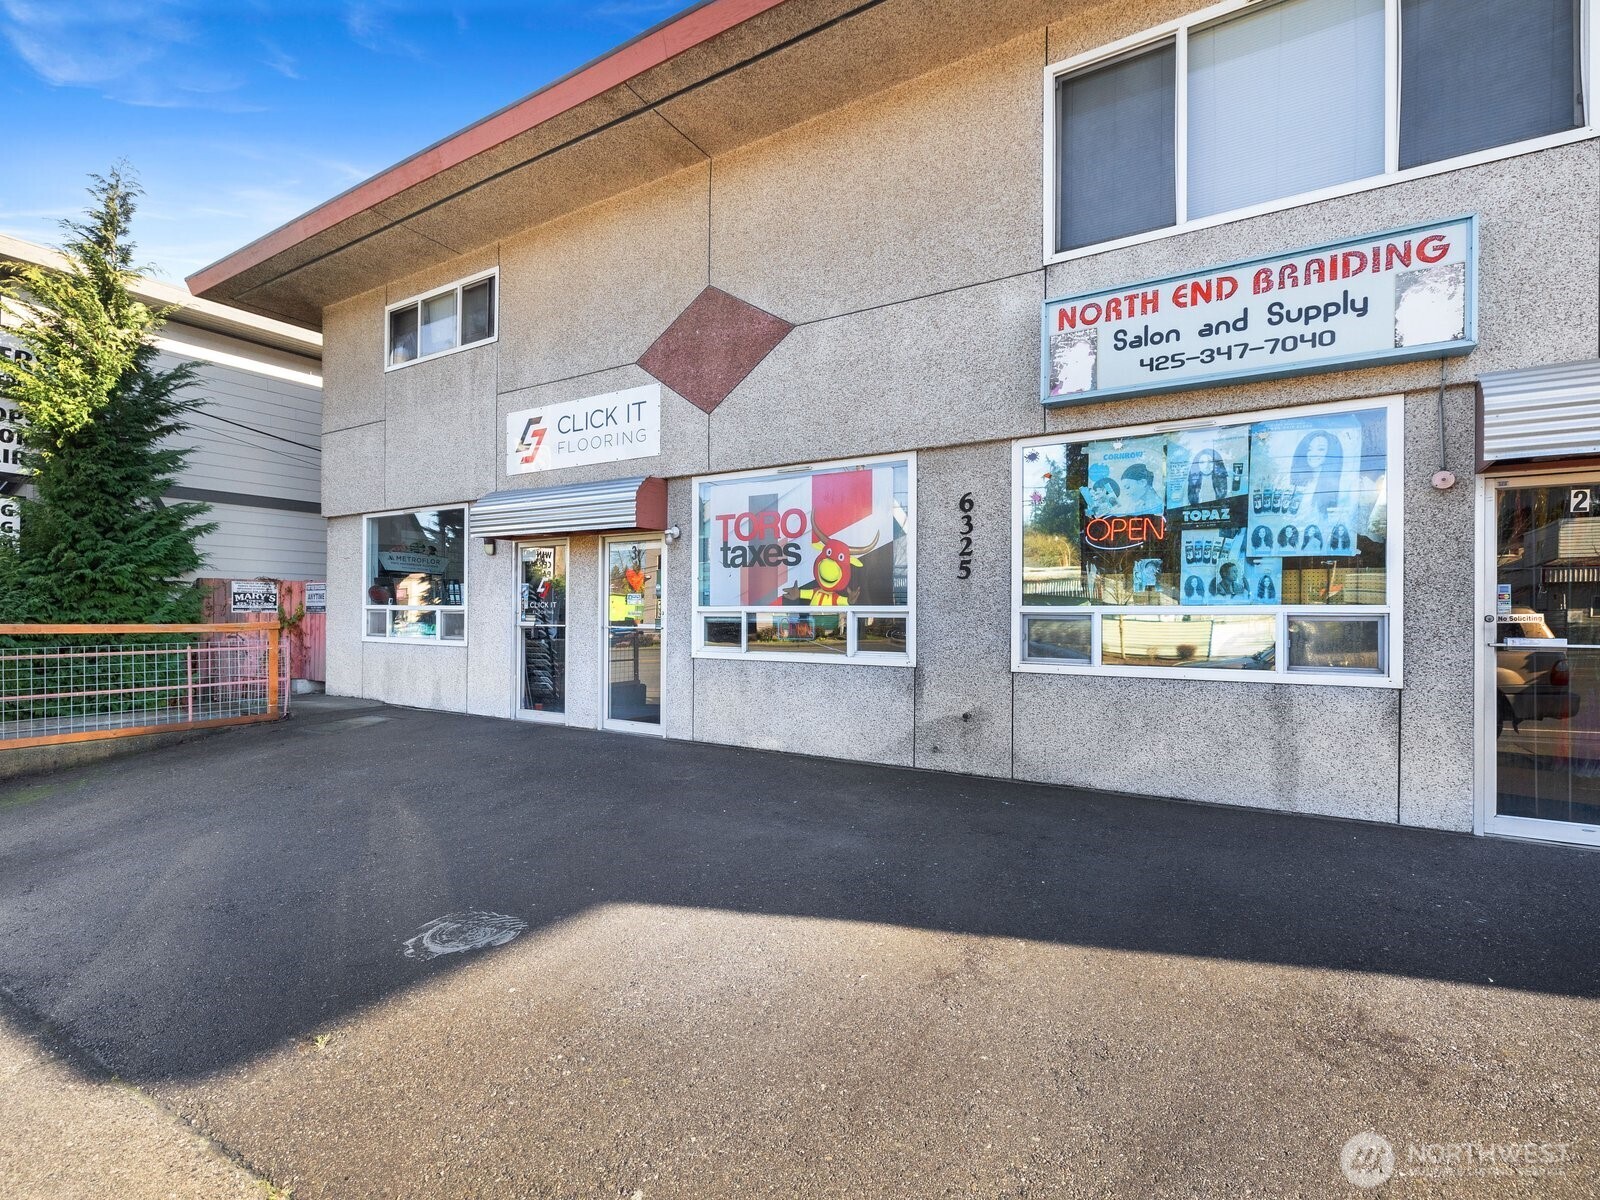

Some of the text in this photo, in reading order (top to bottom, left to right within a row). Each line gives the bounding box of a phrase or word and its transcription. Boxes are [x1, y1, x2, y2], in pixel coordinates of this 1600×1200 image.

[1058, 234, 1451, 331] NORTH END BRAIDING
[1113, 289, 1369, 351] Salon and Supply
[1140, 330, 1336, 372] 425-347-7040
[557, 400, 647, 434] CLICK IT
[557, 428, 647, 454] FLOORING
[1573, 490, 1588, 512] 2
[715, 508, 807, 542] TORO
[1182, 508, 1230, 522] TOPAZ
[1086, 517, 1165, 542] OPEN
[396, 555, 440, 565] METROFLOR
[720, 541, 802, 568] taxes
[234, 593, 276, 602] MARY'S
